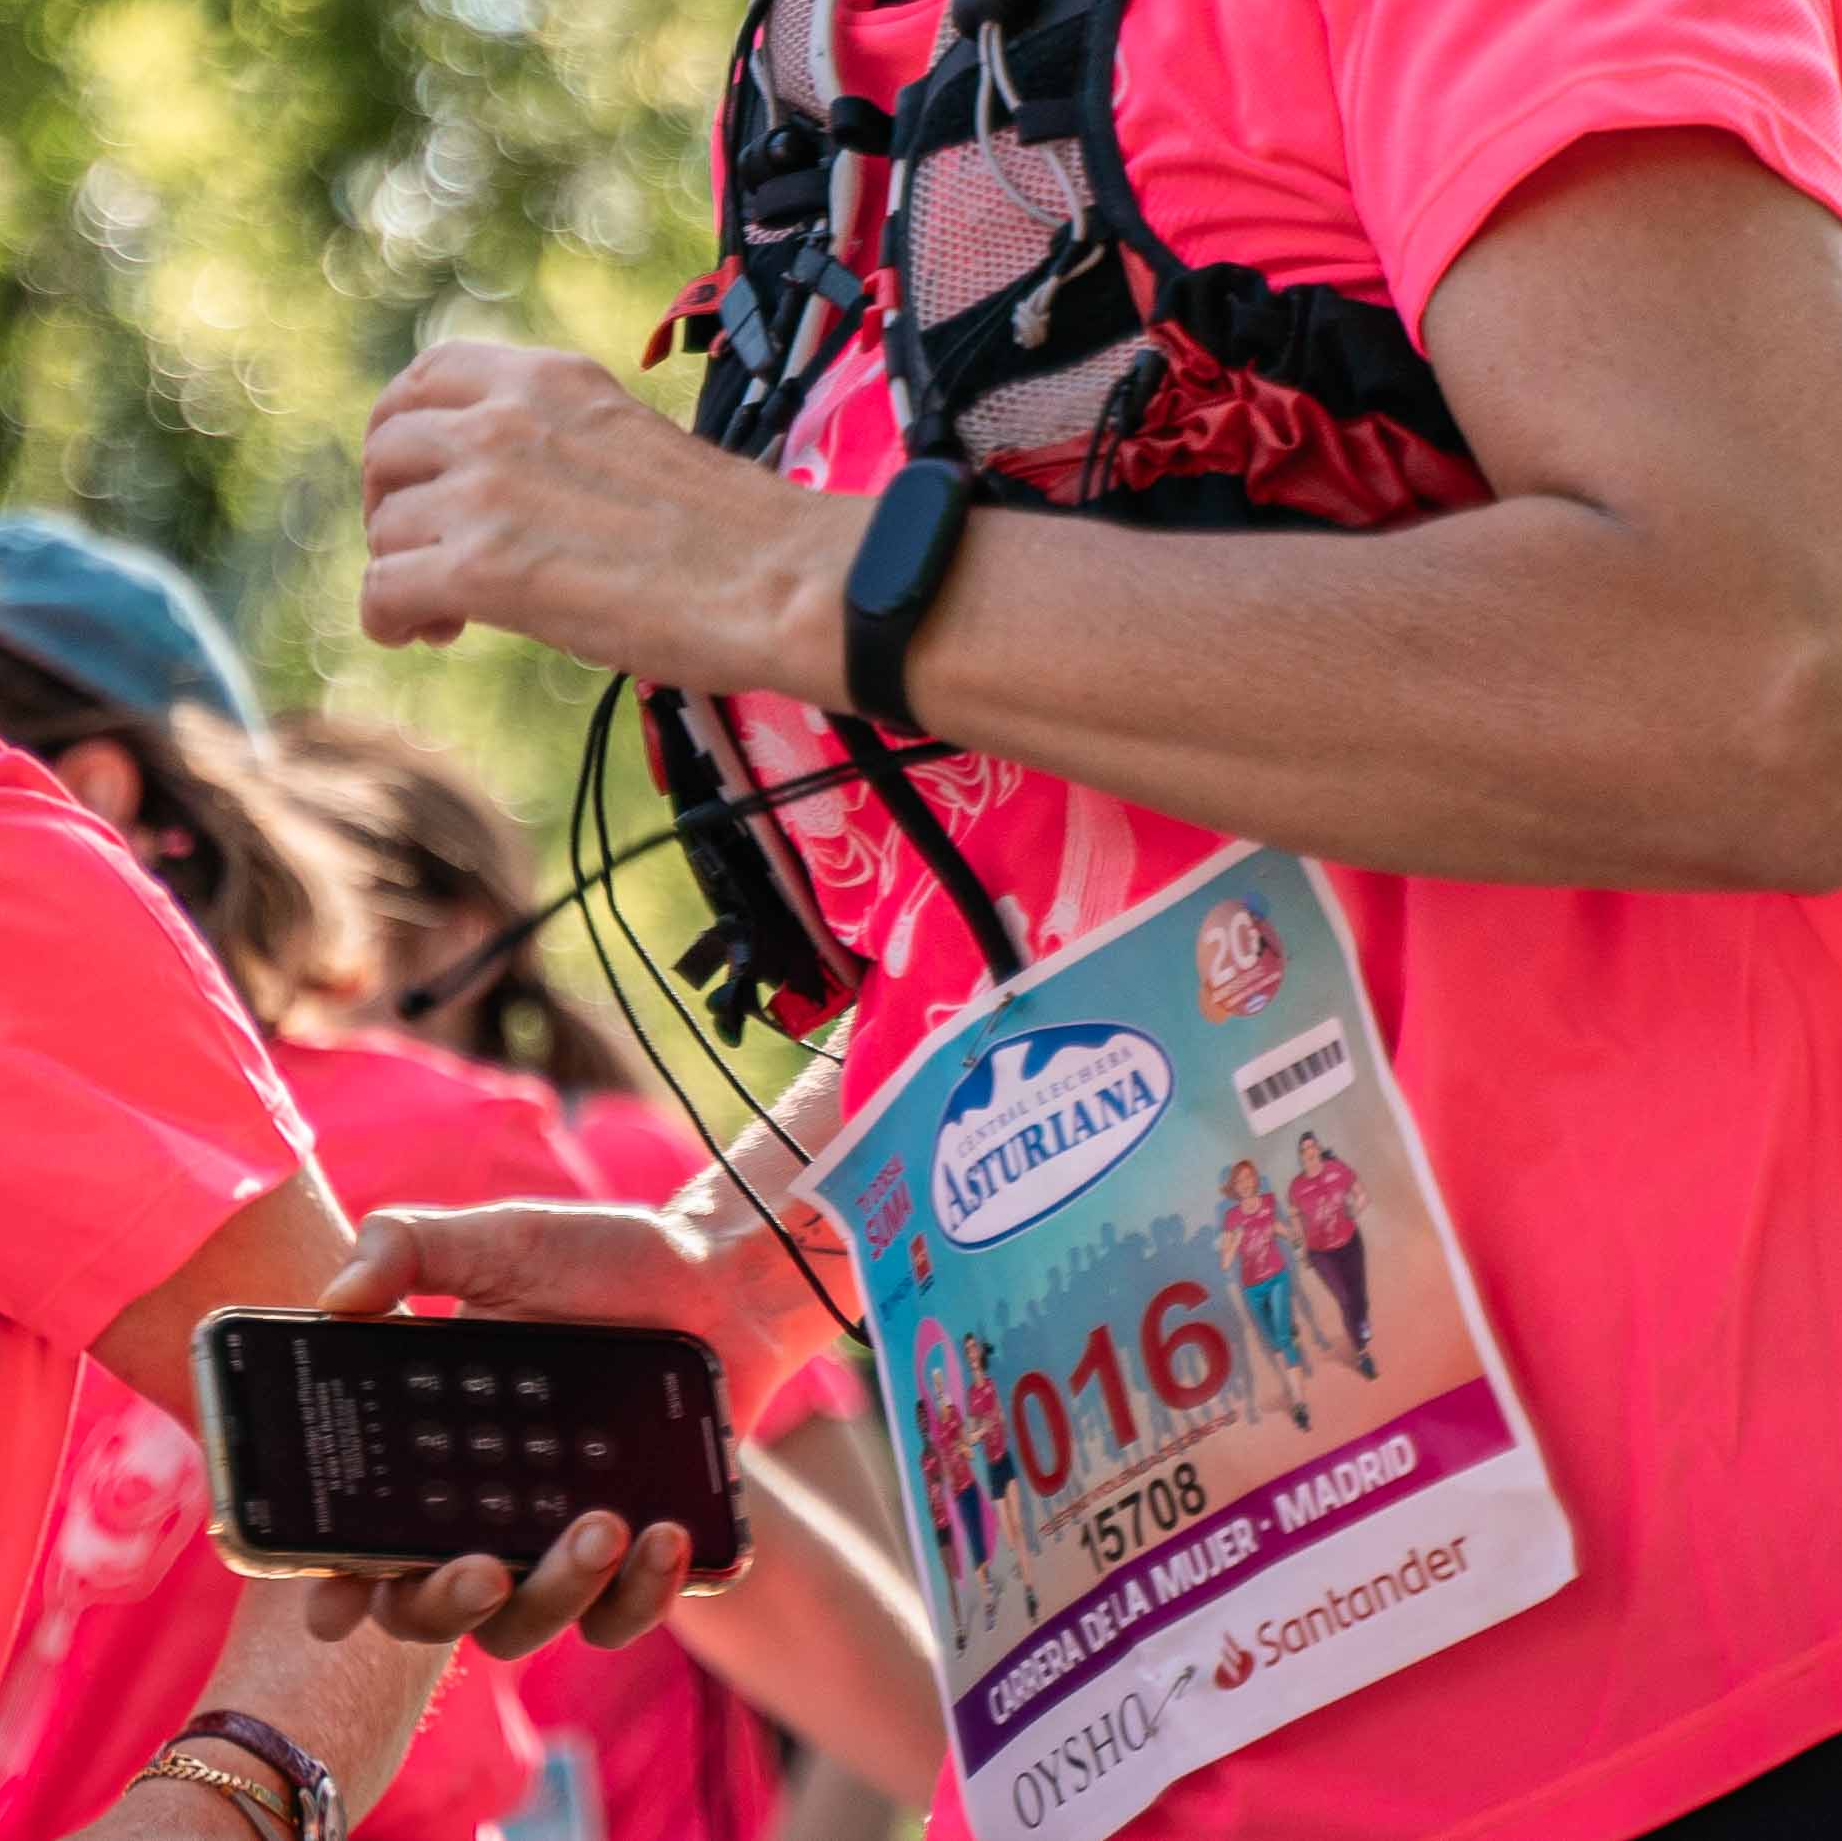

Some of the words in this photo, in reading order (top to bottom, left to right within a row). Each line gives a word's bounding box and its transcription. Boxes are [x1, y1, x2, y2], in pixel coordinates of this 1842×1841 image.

[1203, 910, 1260, 986] 20
[942, 1069, 1159, 1232] ASTURIANA
[958, 1101, 1029, 1157] CENTRAL
[1036, 1047, 1134, 1106] LECHERA
[1011, 1281, 1233, 1497] 016
[989, 1629, 1087, 1725] CARRERA
[1149, 1518, 1259, 1605] MUJER
[1273, 1433, 1416, 1534] MADRID
[1080, 1462, 1206, 1574] 15708
[1257, 1535, 1468, 1667] Santander
[1013, 1692, 1152, 1829] OYSHO
